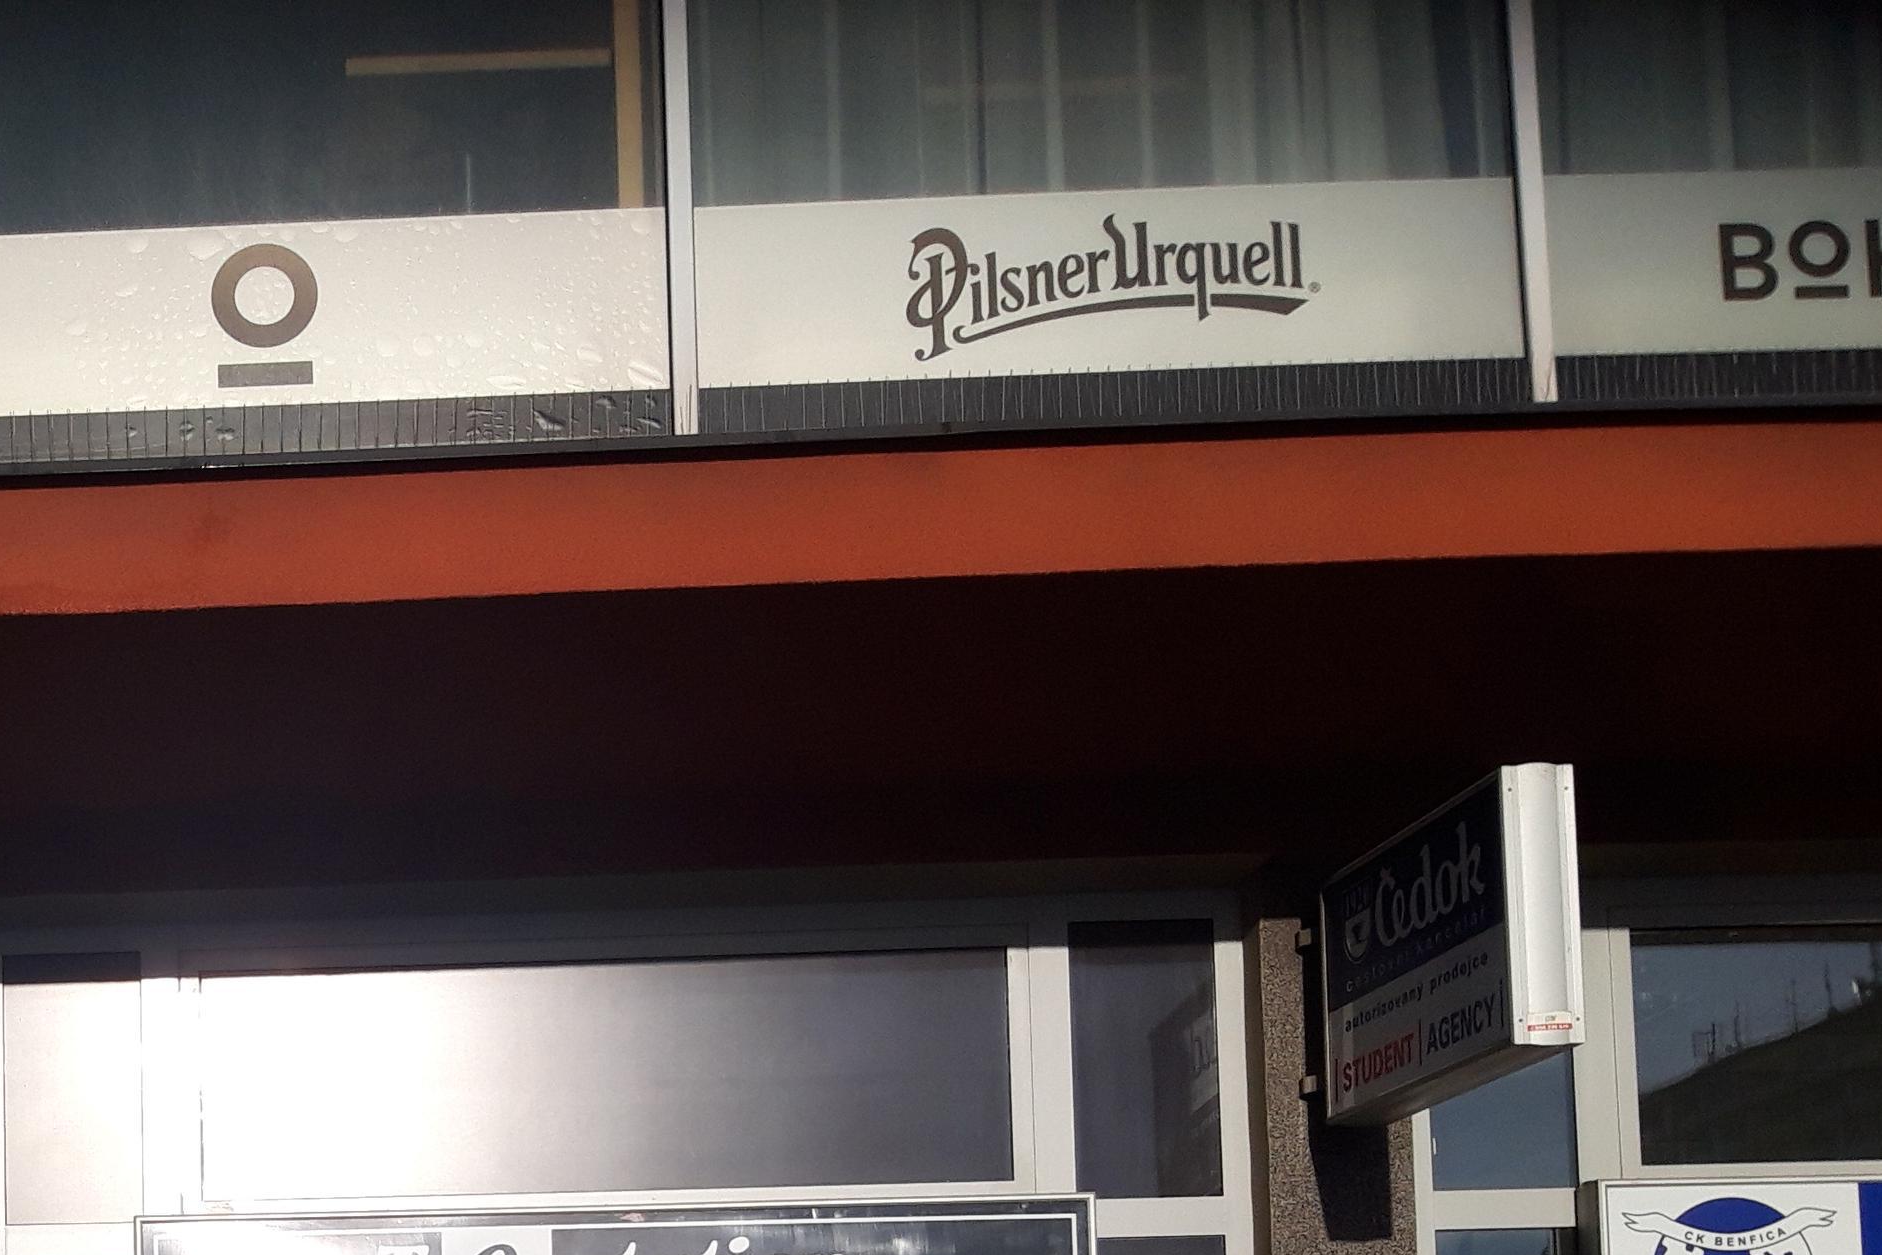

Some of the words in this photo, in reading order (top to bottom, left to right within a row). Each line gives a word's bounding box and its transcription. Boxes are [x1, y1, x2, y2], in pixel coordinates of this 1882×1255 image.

[905, 228, 1111, 361] Pilsner
[1102, 213, 1305, 321] Urquell
[1375, 822, 1485, 947] Čedok
[1343, 1032, 1414, 1093] STUDENT
[1426, 994, 1496, 1055] AGENCY
[1684, 1231, 1704, 1243] CK
[1714, 1227, 1787, 1246] BENFICA
